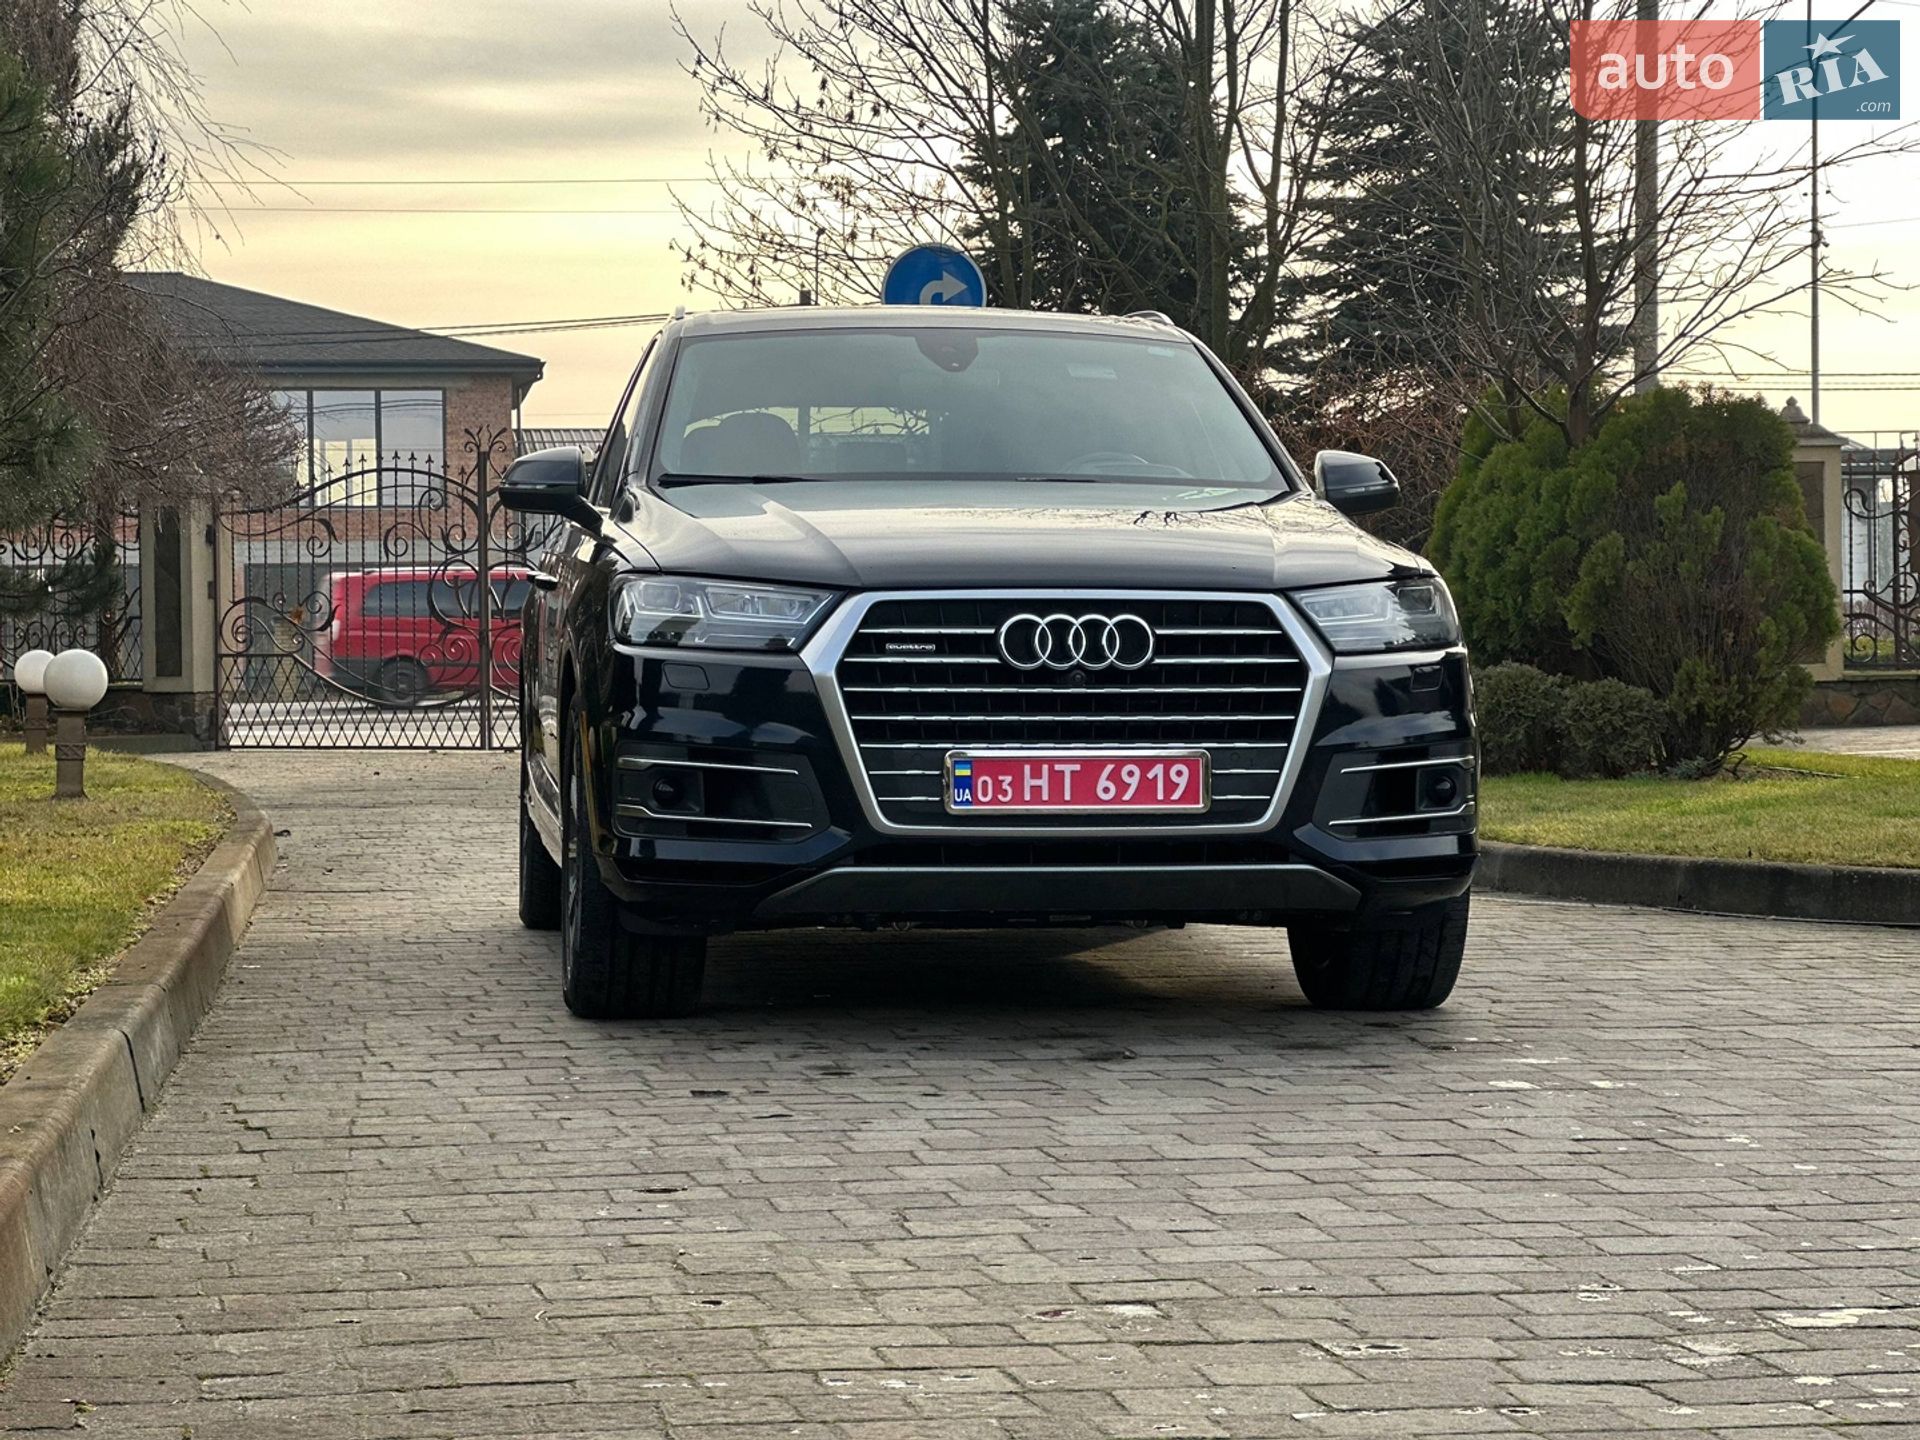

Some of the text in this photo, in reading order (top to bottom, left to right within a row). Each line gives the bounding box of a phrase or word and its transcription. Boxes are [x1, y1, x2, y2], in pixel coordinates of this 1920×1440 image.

[954, 789, 972, 802] UA
[976, 764, 1190, 803] 03 HT 6919
